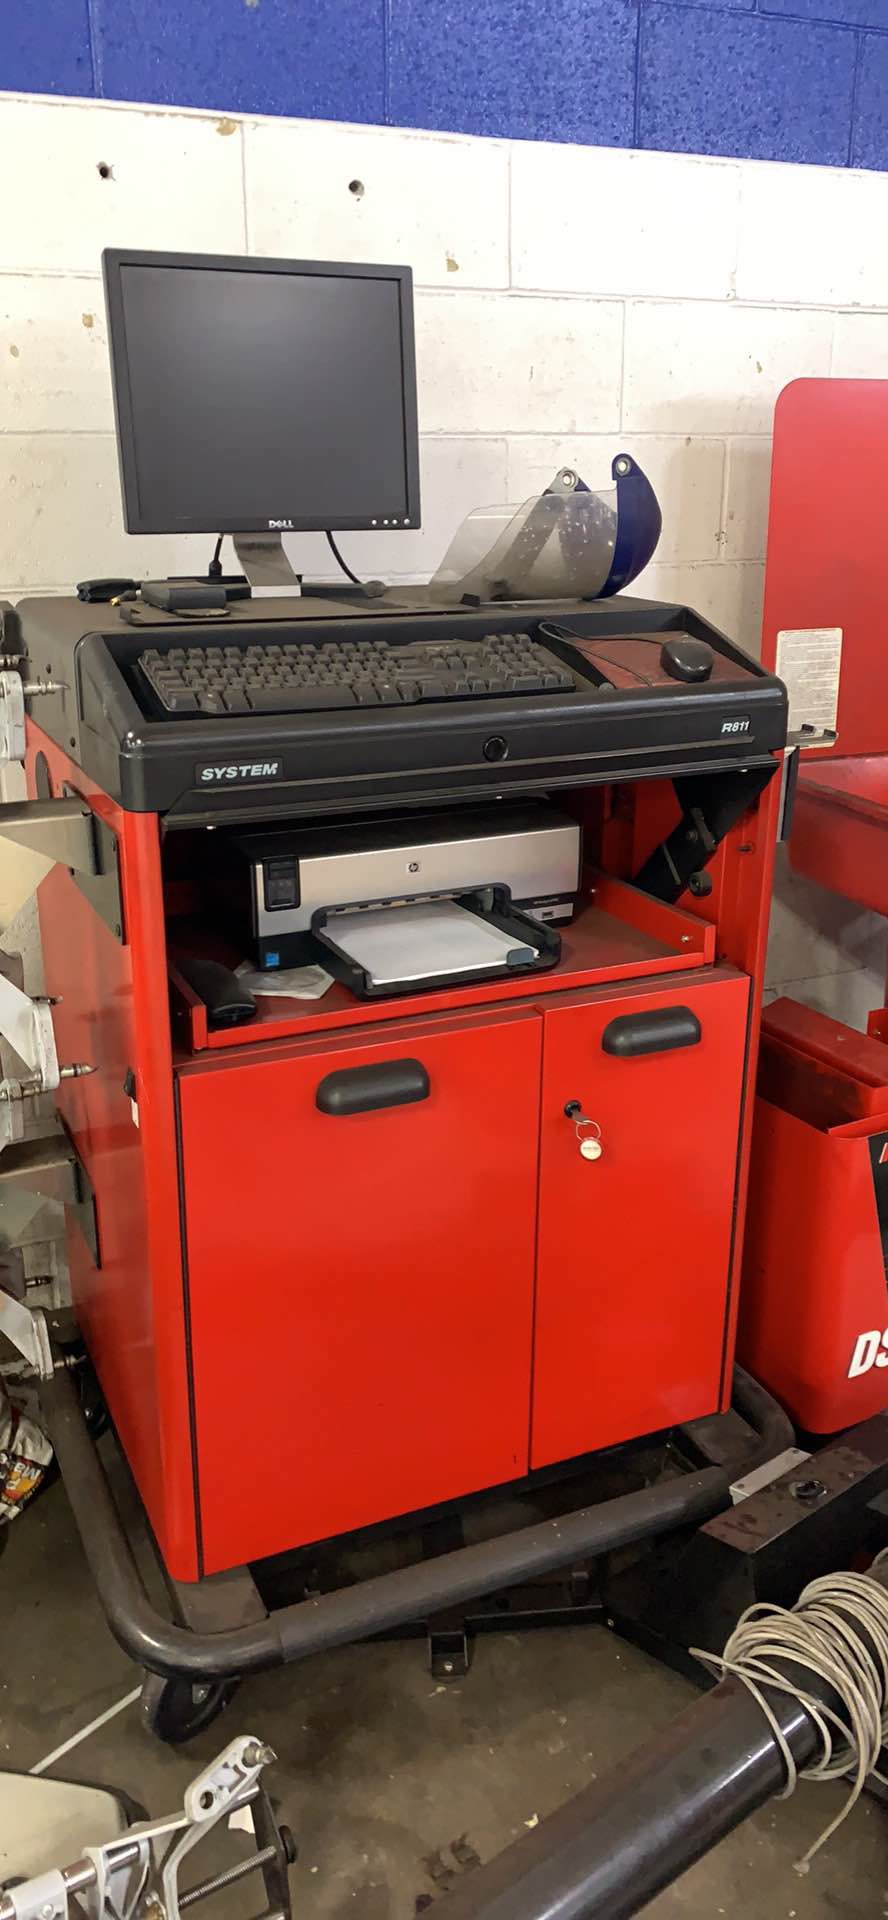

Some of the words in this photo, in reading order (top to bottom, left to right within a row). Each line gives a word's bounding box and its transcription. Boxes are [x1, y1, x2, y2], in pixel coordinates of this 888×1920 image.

[268, 519, 294, 529] DELL
[721, 721, 750, 733] R811
[201, 762, 278, 780] SYSTEM
